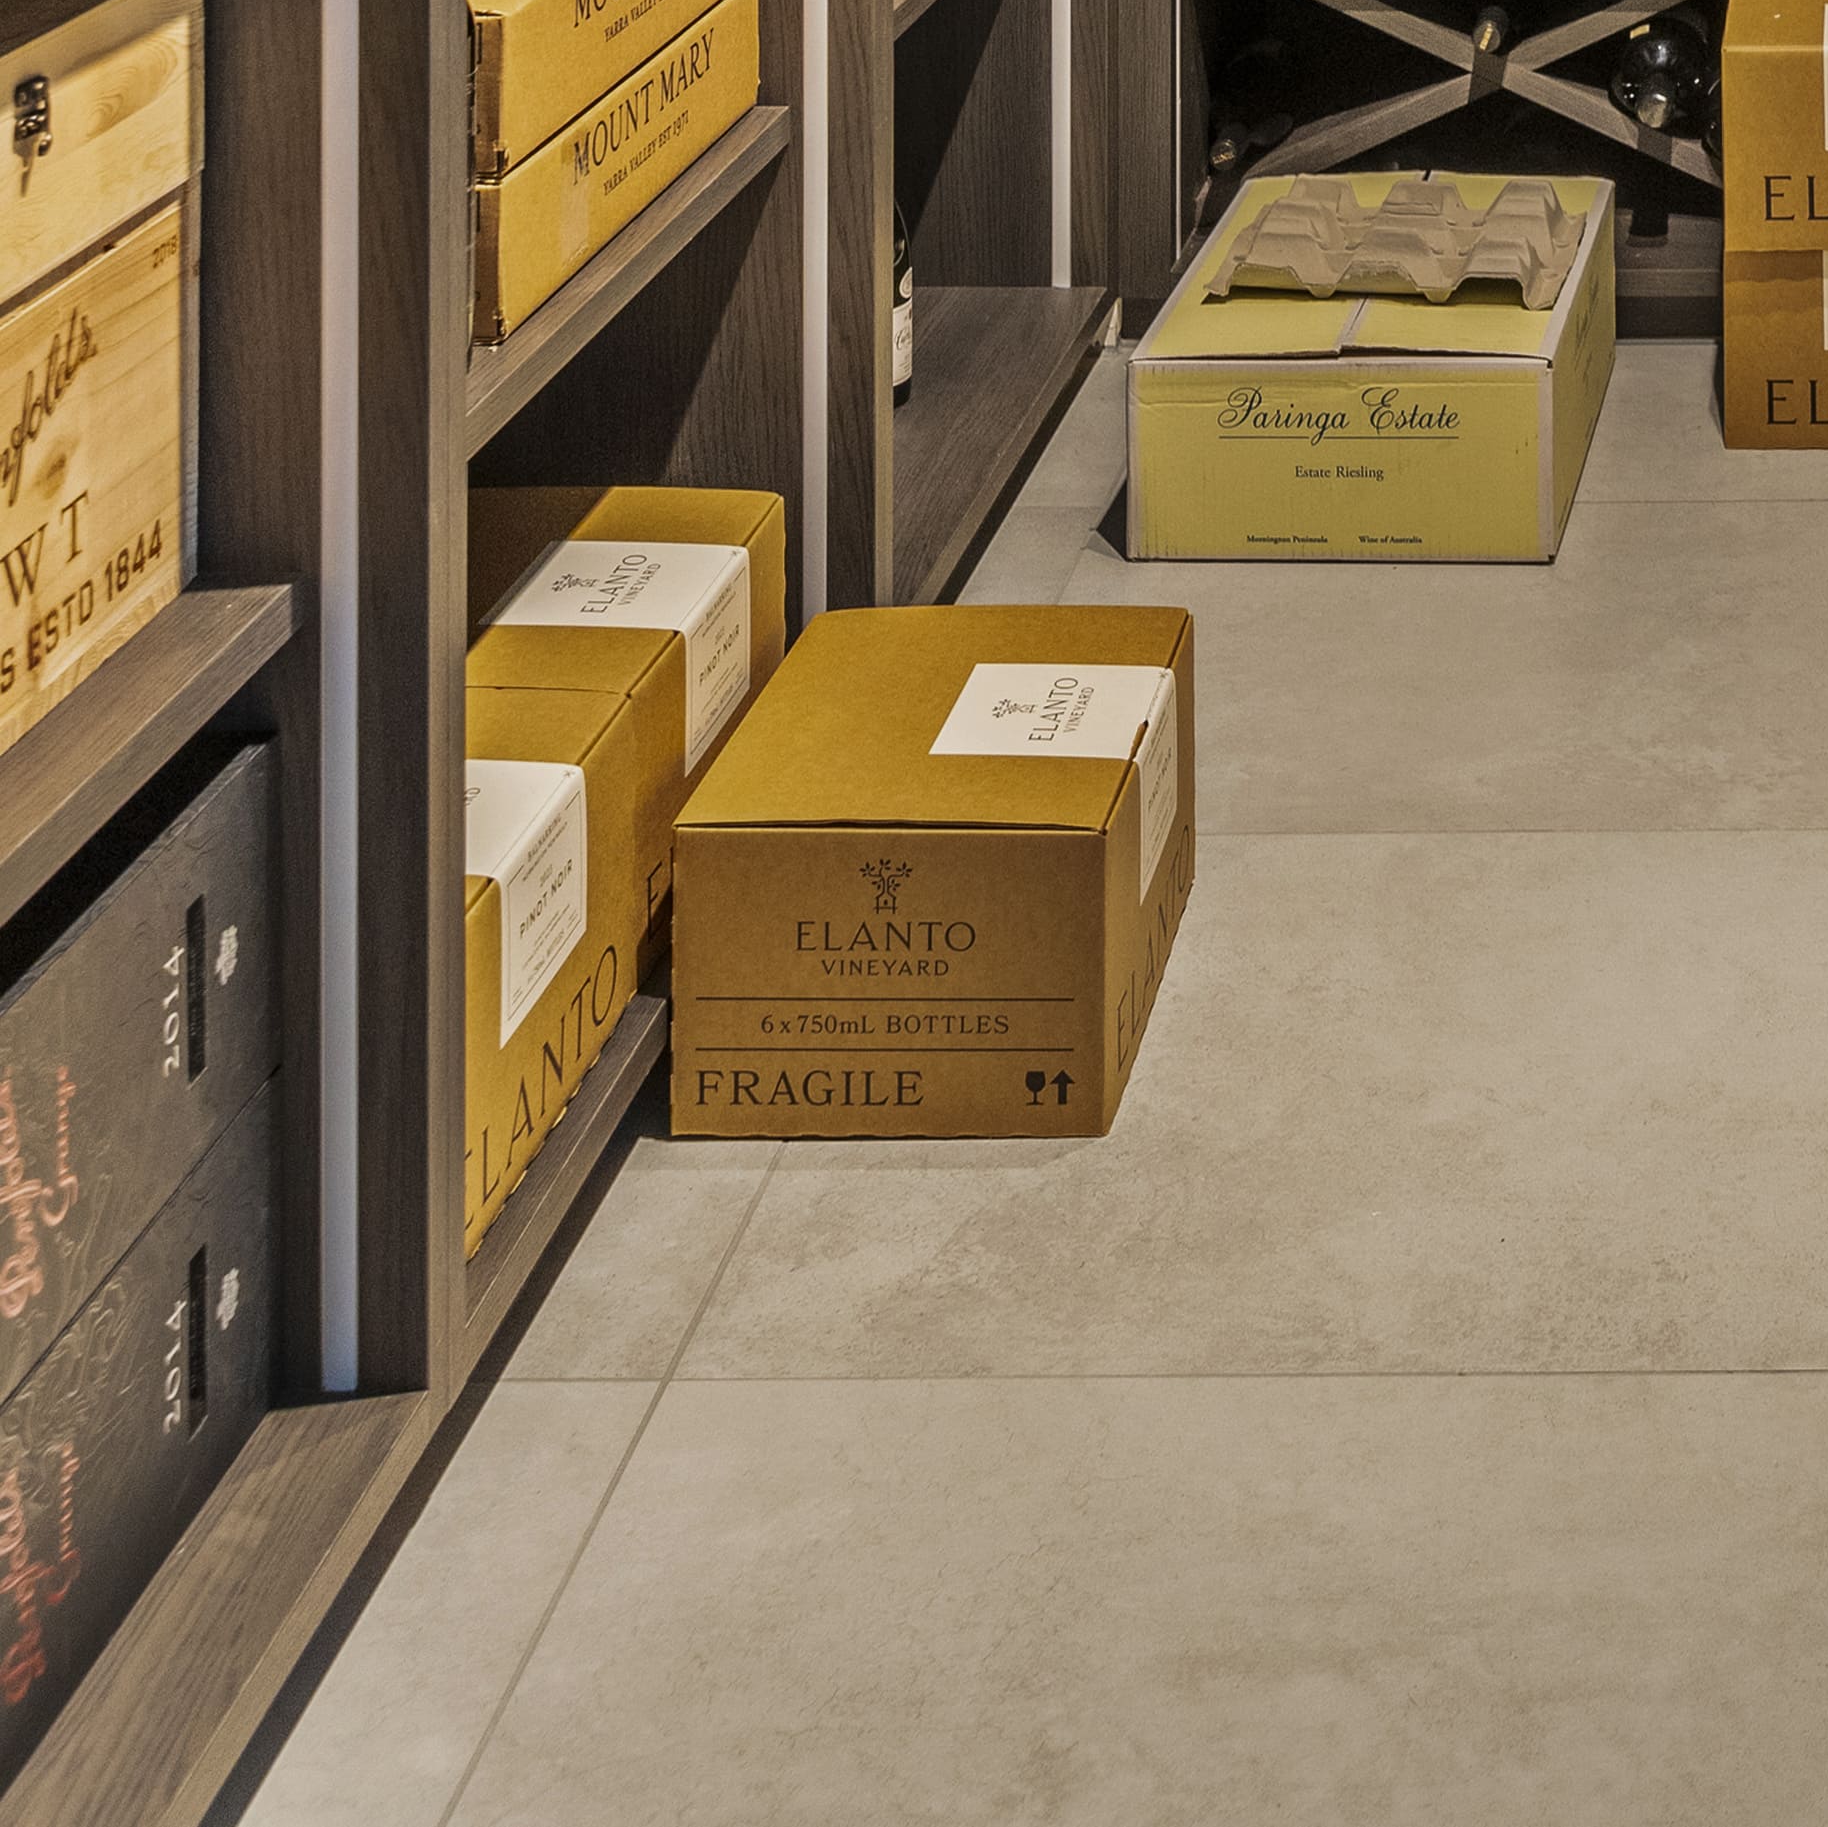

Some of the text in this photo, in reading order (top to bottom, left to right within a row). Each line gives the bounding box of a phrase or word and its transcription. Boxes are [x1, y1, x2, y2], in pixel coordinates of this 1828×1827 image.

[604, 13, 629, 44] YARRA
[572, 28, 715, 187] MOUNT MARY
[603, 109, 690, 196] YARRA VALLEY EST 1971
[152, 235, 179, 268] 2018
[1217, 386, 1461, 446] Paringa Estate
[1294, 464, 1385, 482] Estate Riesling
[1246, 534, 1328, 545] Mornington Peninsula
[1359, 534, 1423, 544] Wine of Australia
[27, 577, 94, 672] ESTD
[104, 518, 163, 604] 1844
[580, 554, 648, 614] ELANTO
[617, 563, 662, 606] VINEYARD
[699, 649, 722, 686] PINOT
[723, 624, 741, 654] NOIR
[1028, 676, 1080, 744] ELANTO
[1061, 685, 1096, 735] VINEYARD
[519, 890, 548, 939] PINOT
[549, 858, 573, 899] NOIR
[795, 920, 977, 954] ELANTO
[1116, 823, 1191, 1075] ELANTO
[820, 958, 950, 978] VINEYARD
[162, 946, 184, 1078] 2014
[760, 1013, 1010, 1035] 6 x 750mL BOTTLES
[466, 944, 618, 1233] LANTO
[695, 1069, 925, 1107] FRAGILE
[163, 1300, 187, 1435] 2014
